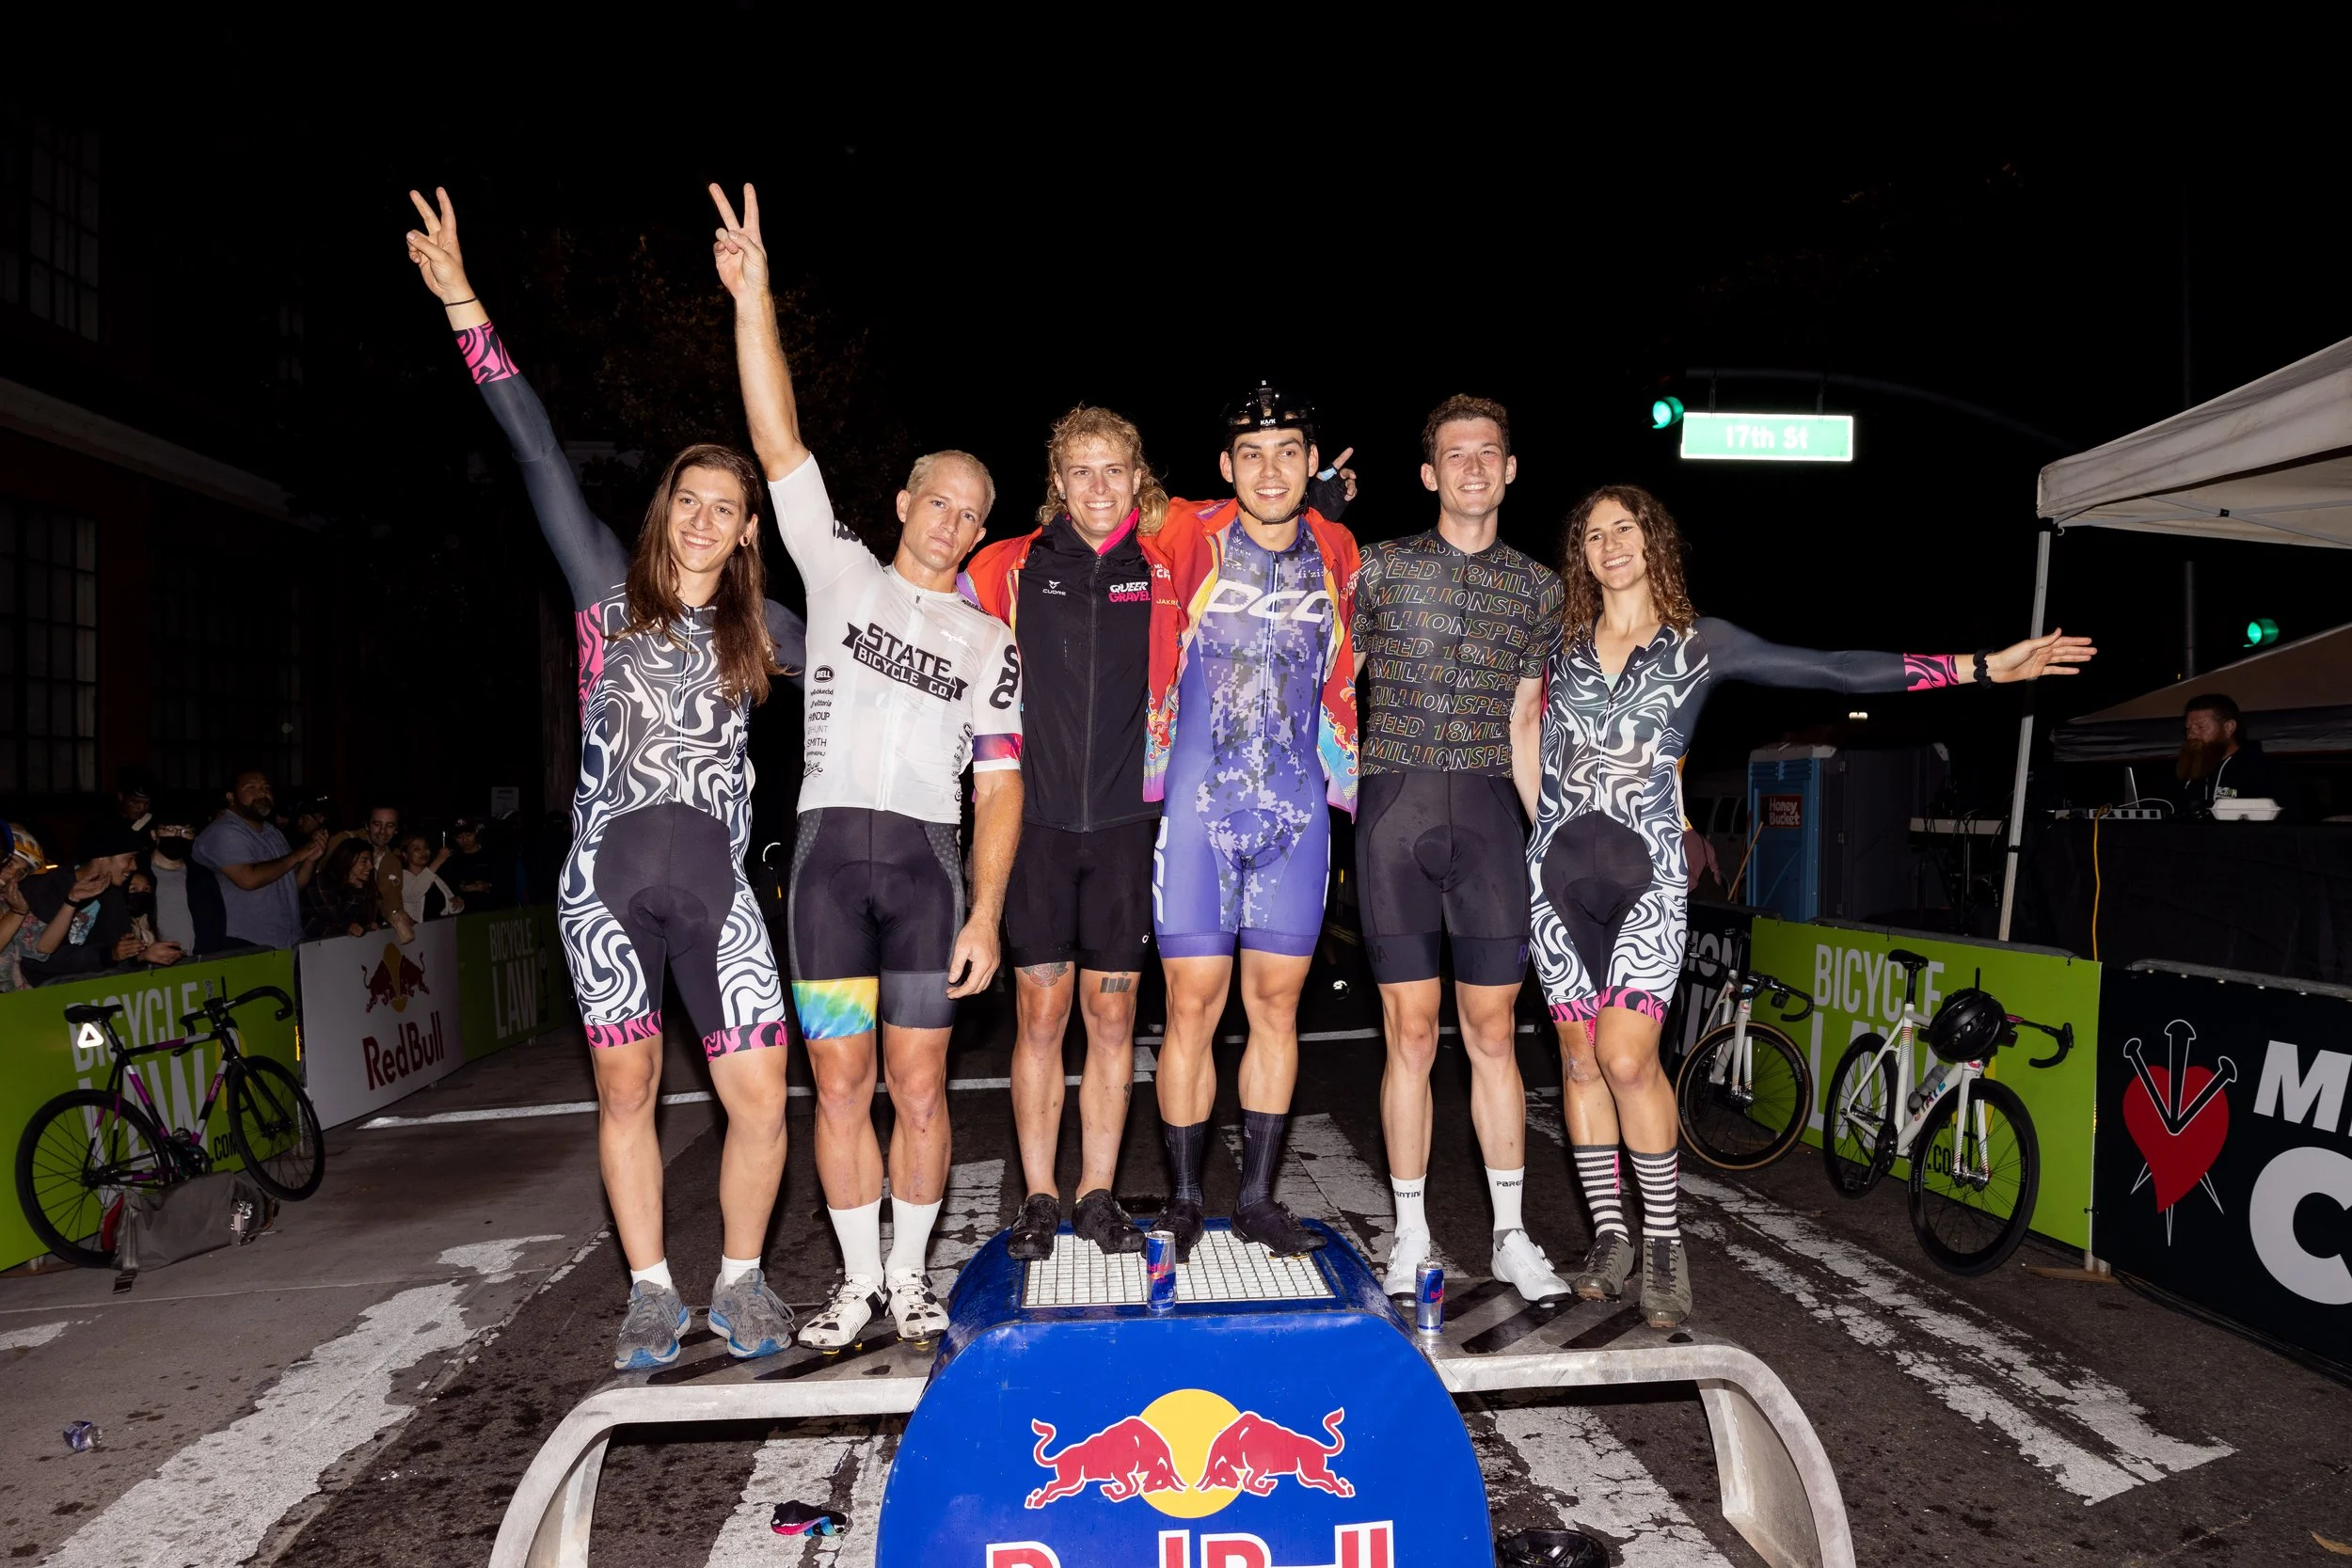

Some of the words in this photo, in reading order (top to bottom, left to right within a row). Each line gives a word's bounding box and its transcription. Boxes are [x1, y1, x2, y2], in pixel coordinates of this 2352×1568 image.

[1724, 424, 1775, 450] 17th
[1782, 424, 1809, 451] St
[1042, 588, 1067, 596] CUORE
[1107, 591, 1152, 603] GRAVEL
[1109, 581, 1150, 594] QUEER
[864, 622, 952, 682] STATE
[816, 670, 832, 678] BELL
[857, 646, 920, 687] BICYCLE
[928, 680, 950, 699] CO.
[806, 737, 828, 748] SMITH
[1769, 797, 1798, 816] Honey
[1769, 812, 1802, 826] Bucket
[489, 917, 535, 963] BICYCLE
[492, 957, 539, 1040] LAW
[362, 1022, 411, 1092] Red
[405, 1009, 445, 1072] Bull
